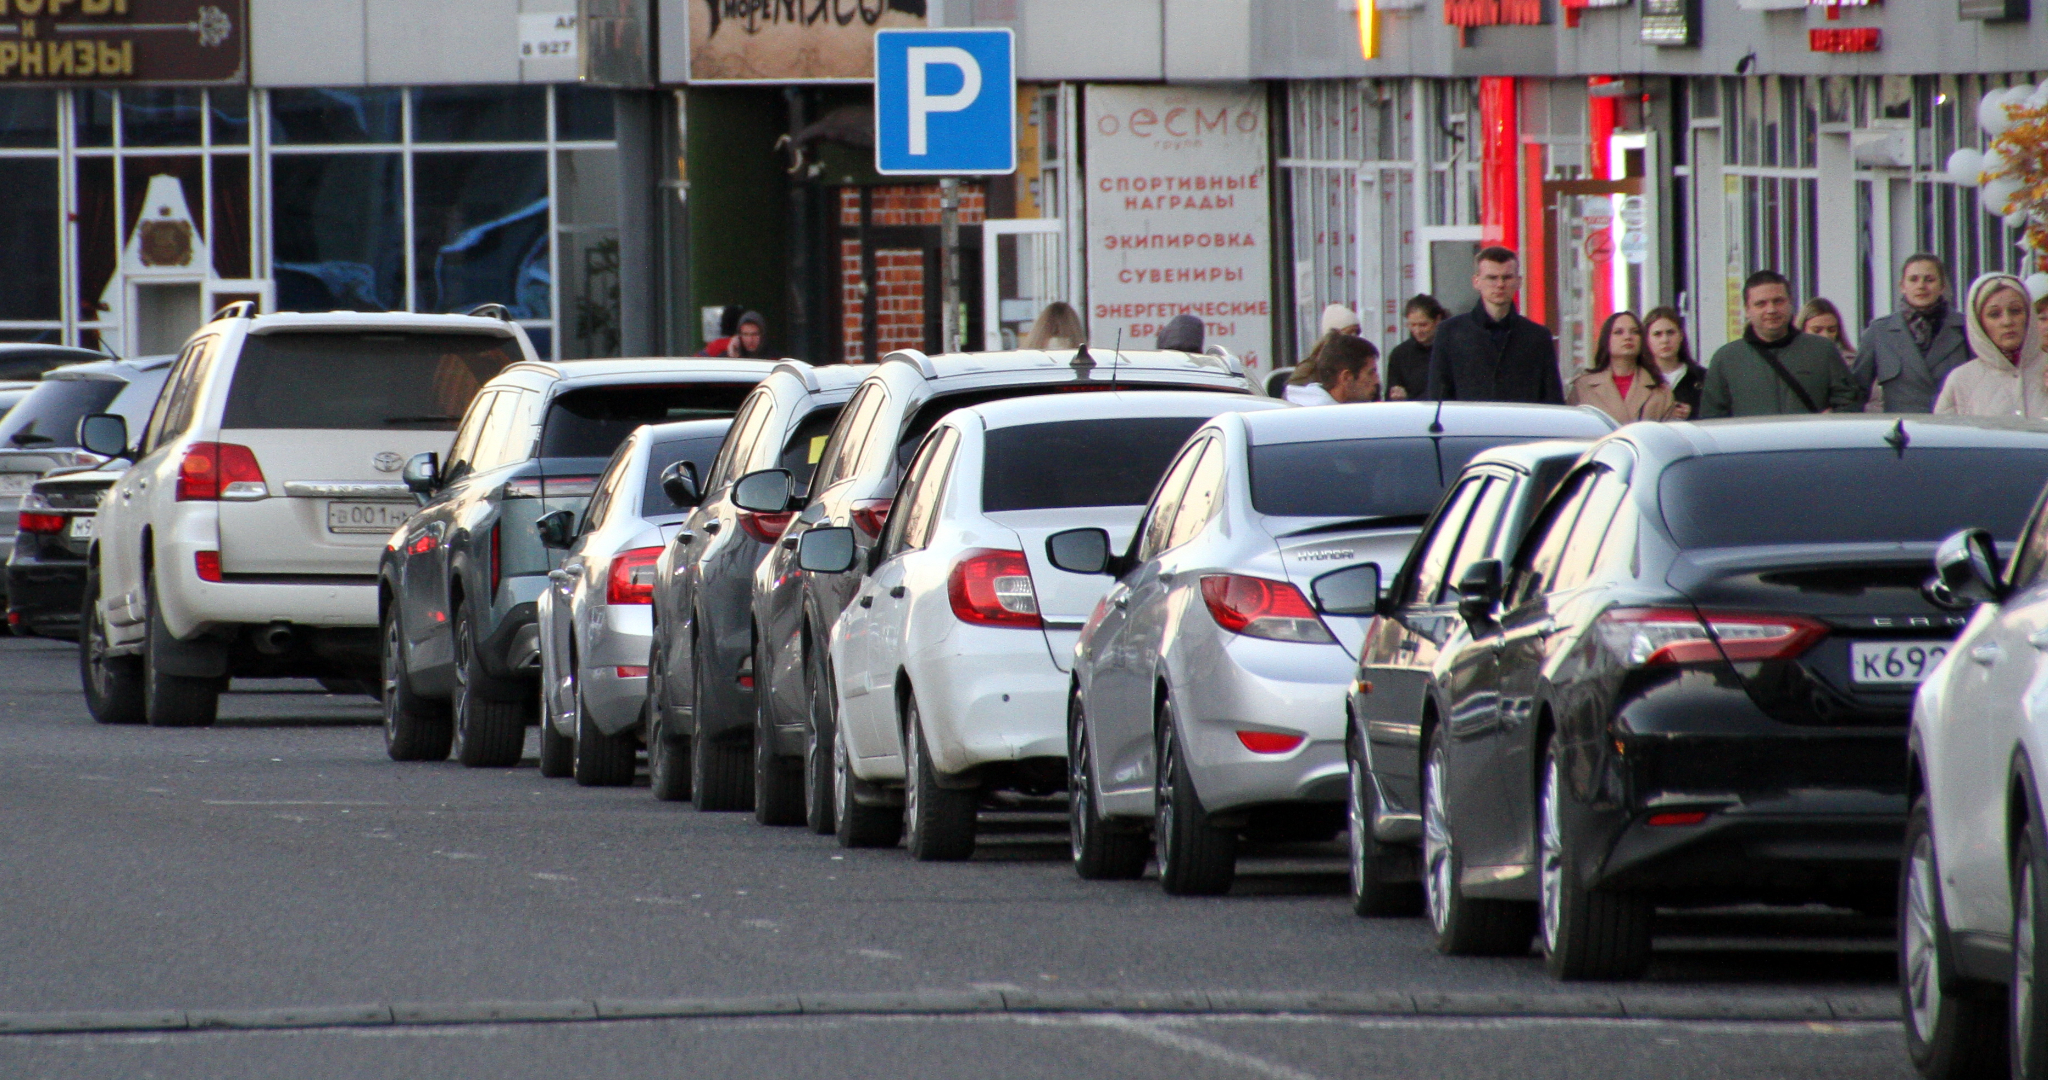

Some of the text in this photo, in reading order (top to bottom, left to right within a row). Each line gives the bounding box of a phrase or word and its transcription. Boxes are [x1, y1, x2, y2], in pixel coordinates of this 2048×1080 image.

[539, 41, 570, 54] 927
[907, 46, 982, 155] P
[1099, 174, 1259, 192] СПОРТИВНЫЕ
[1124, 195, 1235, 210] НАГРАДЫ
[1104, 233, 1256, 250] ЭКИПИРОВКА
[1118, 267, 1244, 283] СУВЕНИРЫ
[1095, 301, 1269, 318] ЭНЕРГЕТИЧЕСКИЕ
[1297, 549, 1354, 561] HYUNDAI
